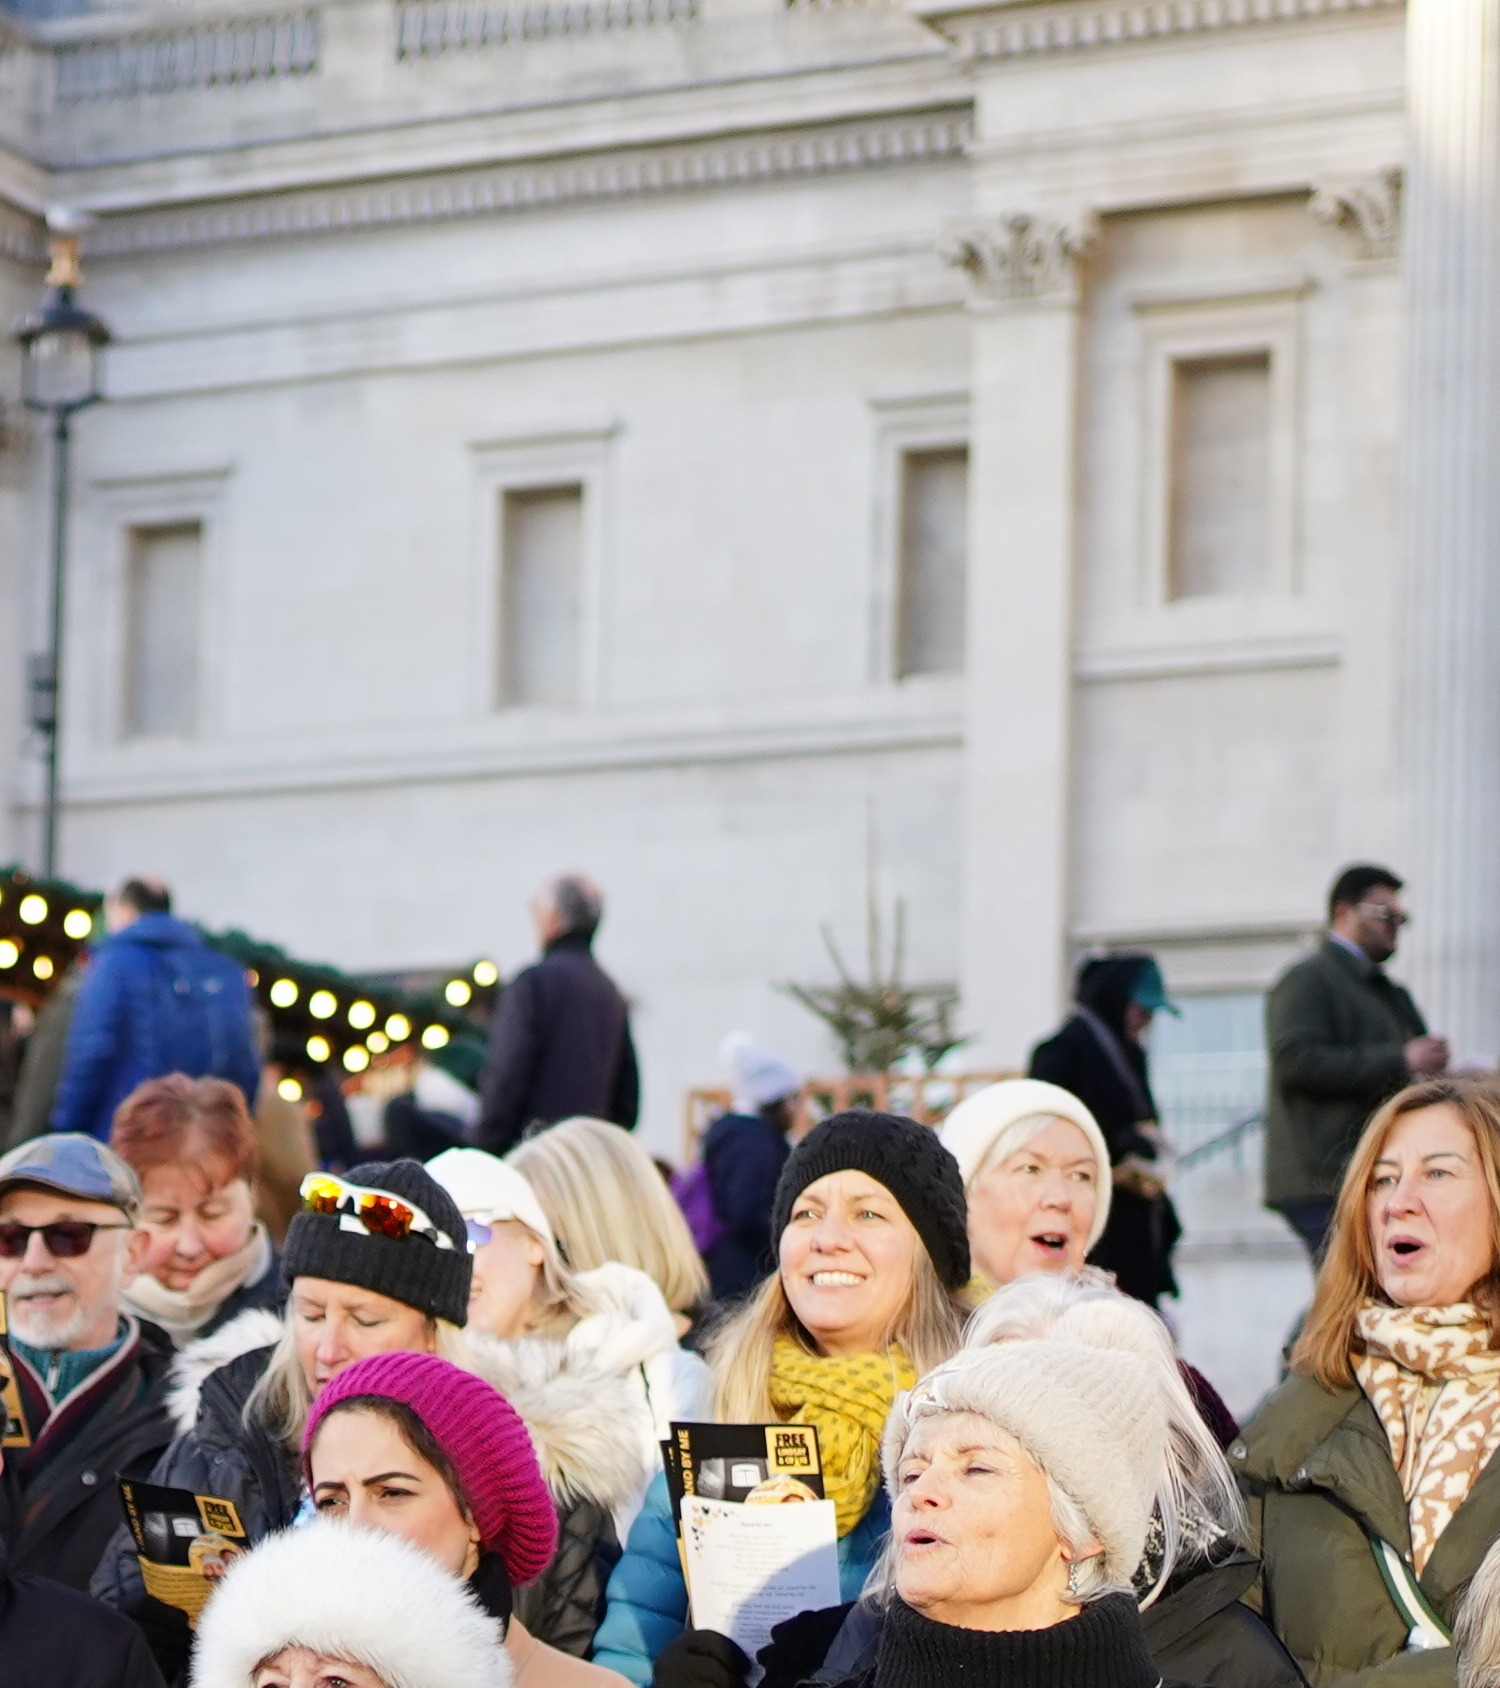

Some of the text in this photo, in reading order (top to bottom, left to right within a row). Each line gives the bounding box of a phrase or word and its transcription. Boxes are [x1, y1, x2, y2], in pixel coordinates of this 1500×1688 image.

[678, 1429, 691, 1450] ME
[775, 1433, 807, 1447] FREE
[680, 1453, 693, 1468] BY
